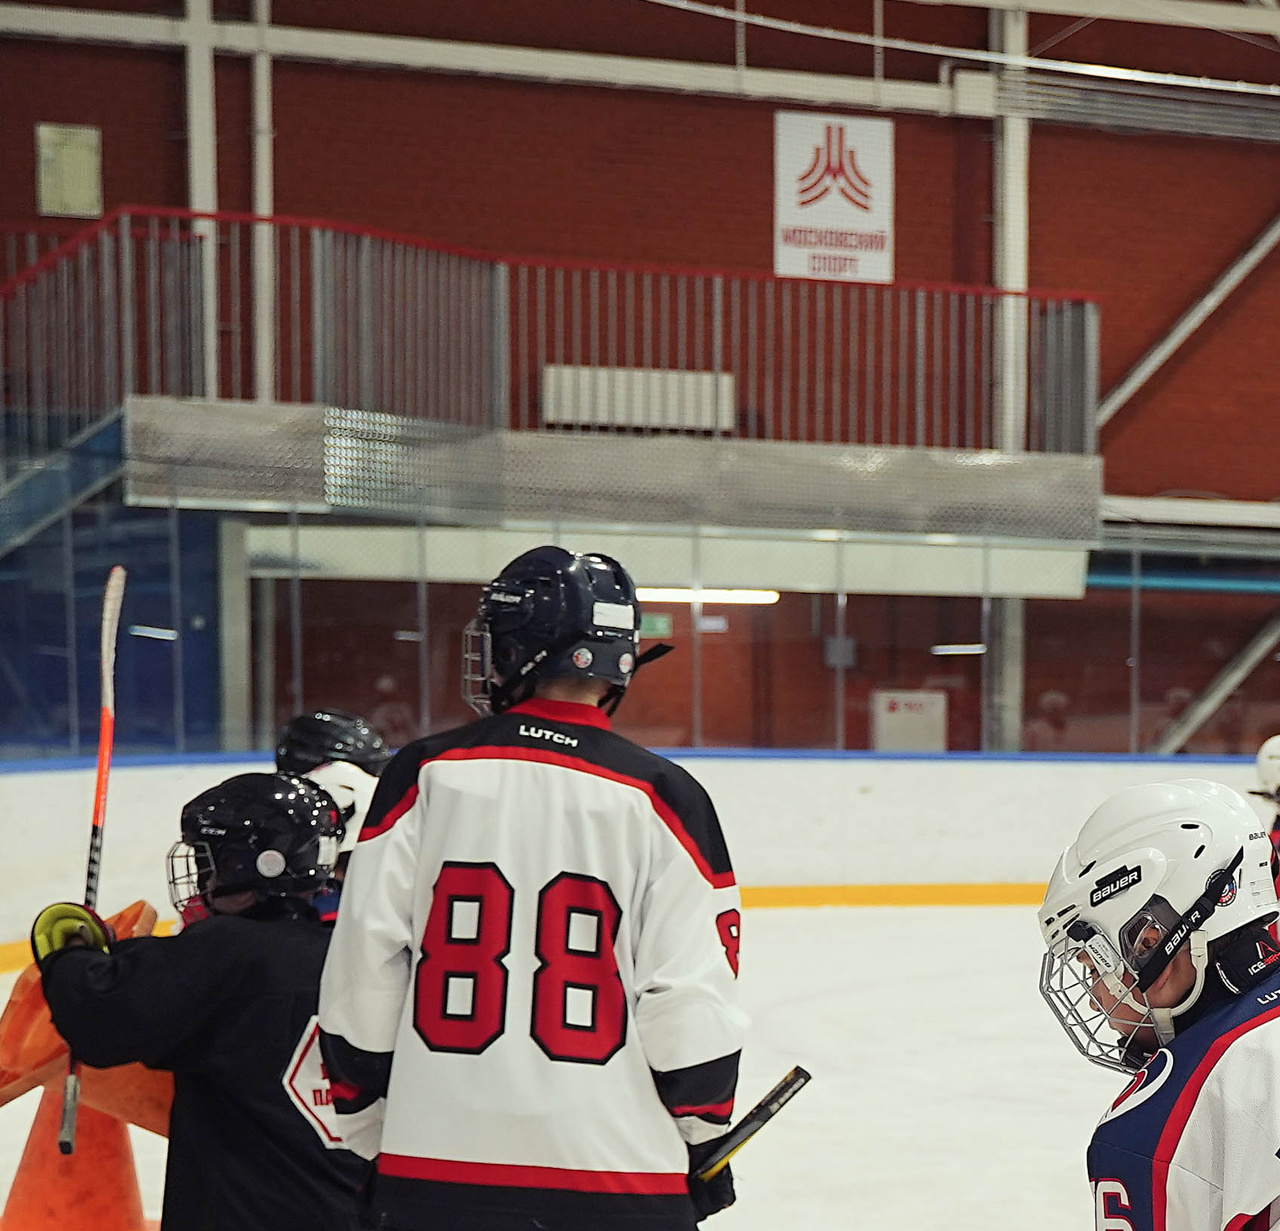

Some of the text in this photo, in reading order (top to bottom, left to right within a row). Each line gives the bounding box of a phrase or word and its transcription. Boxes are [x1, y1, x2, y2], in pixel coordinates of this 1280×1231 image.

[519, 725, 579, 748] LUTCH
[1092, 871, 1139, 903] BAUER
[413, 861, 628, 1066] 88
